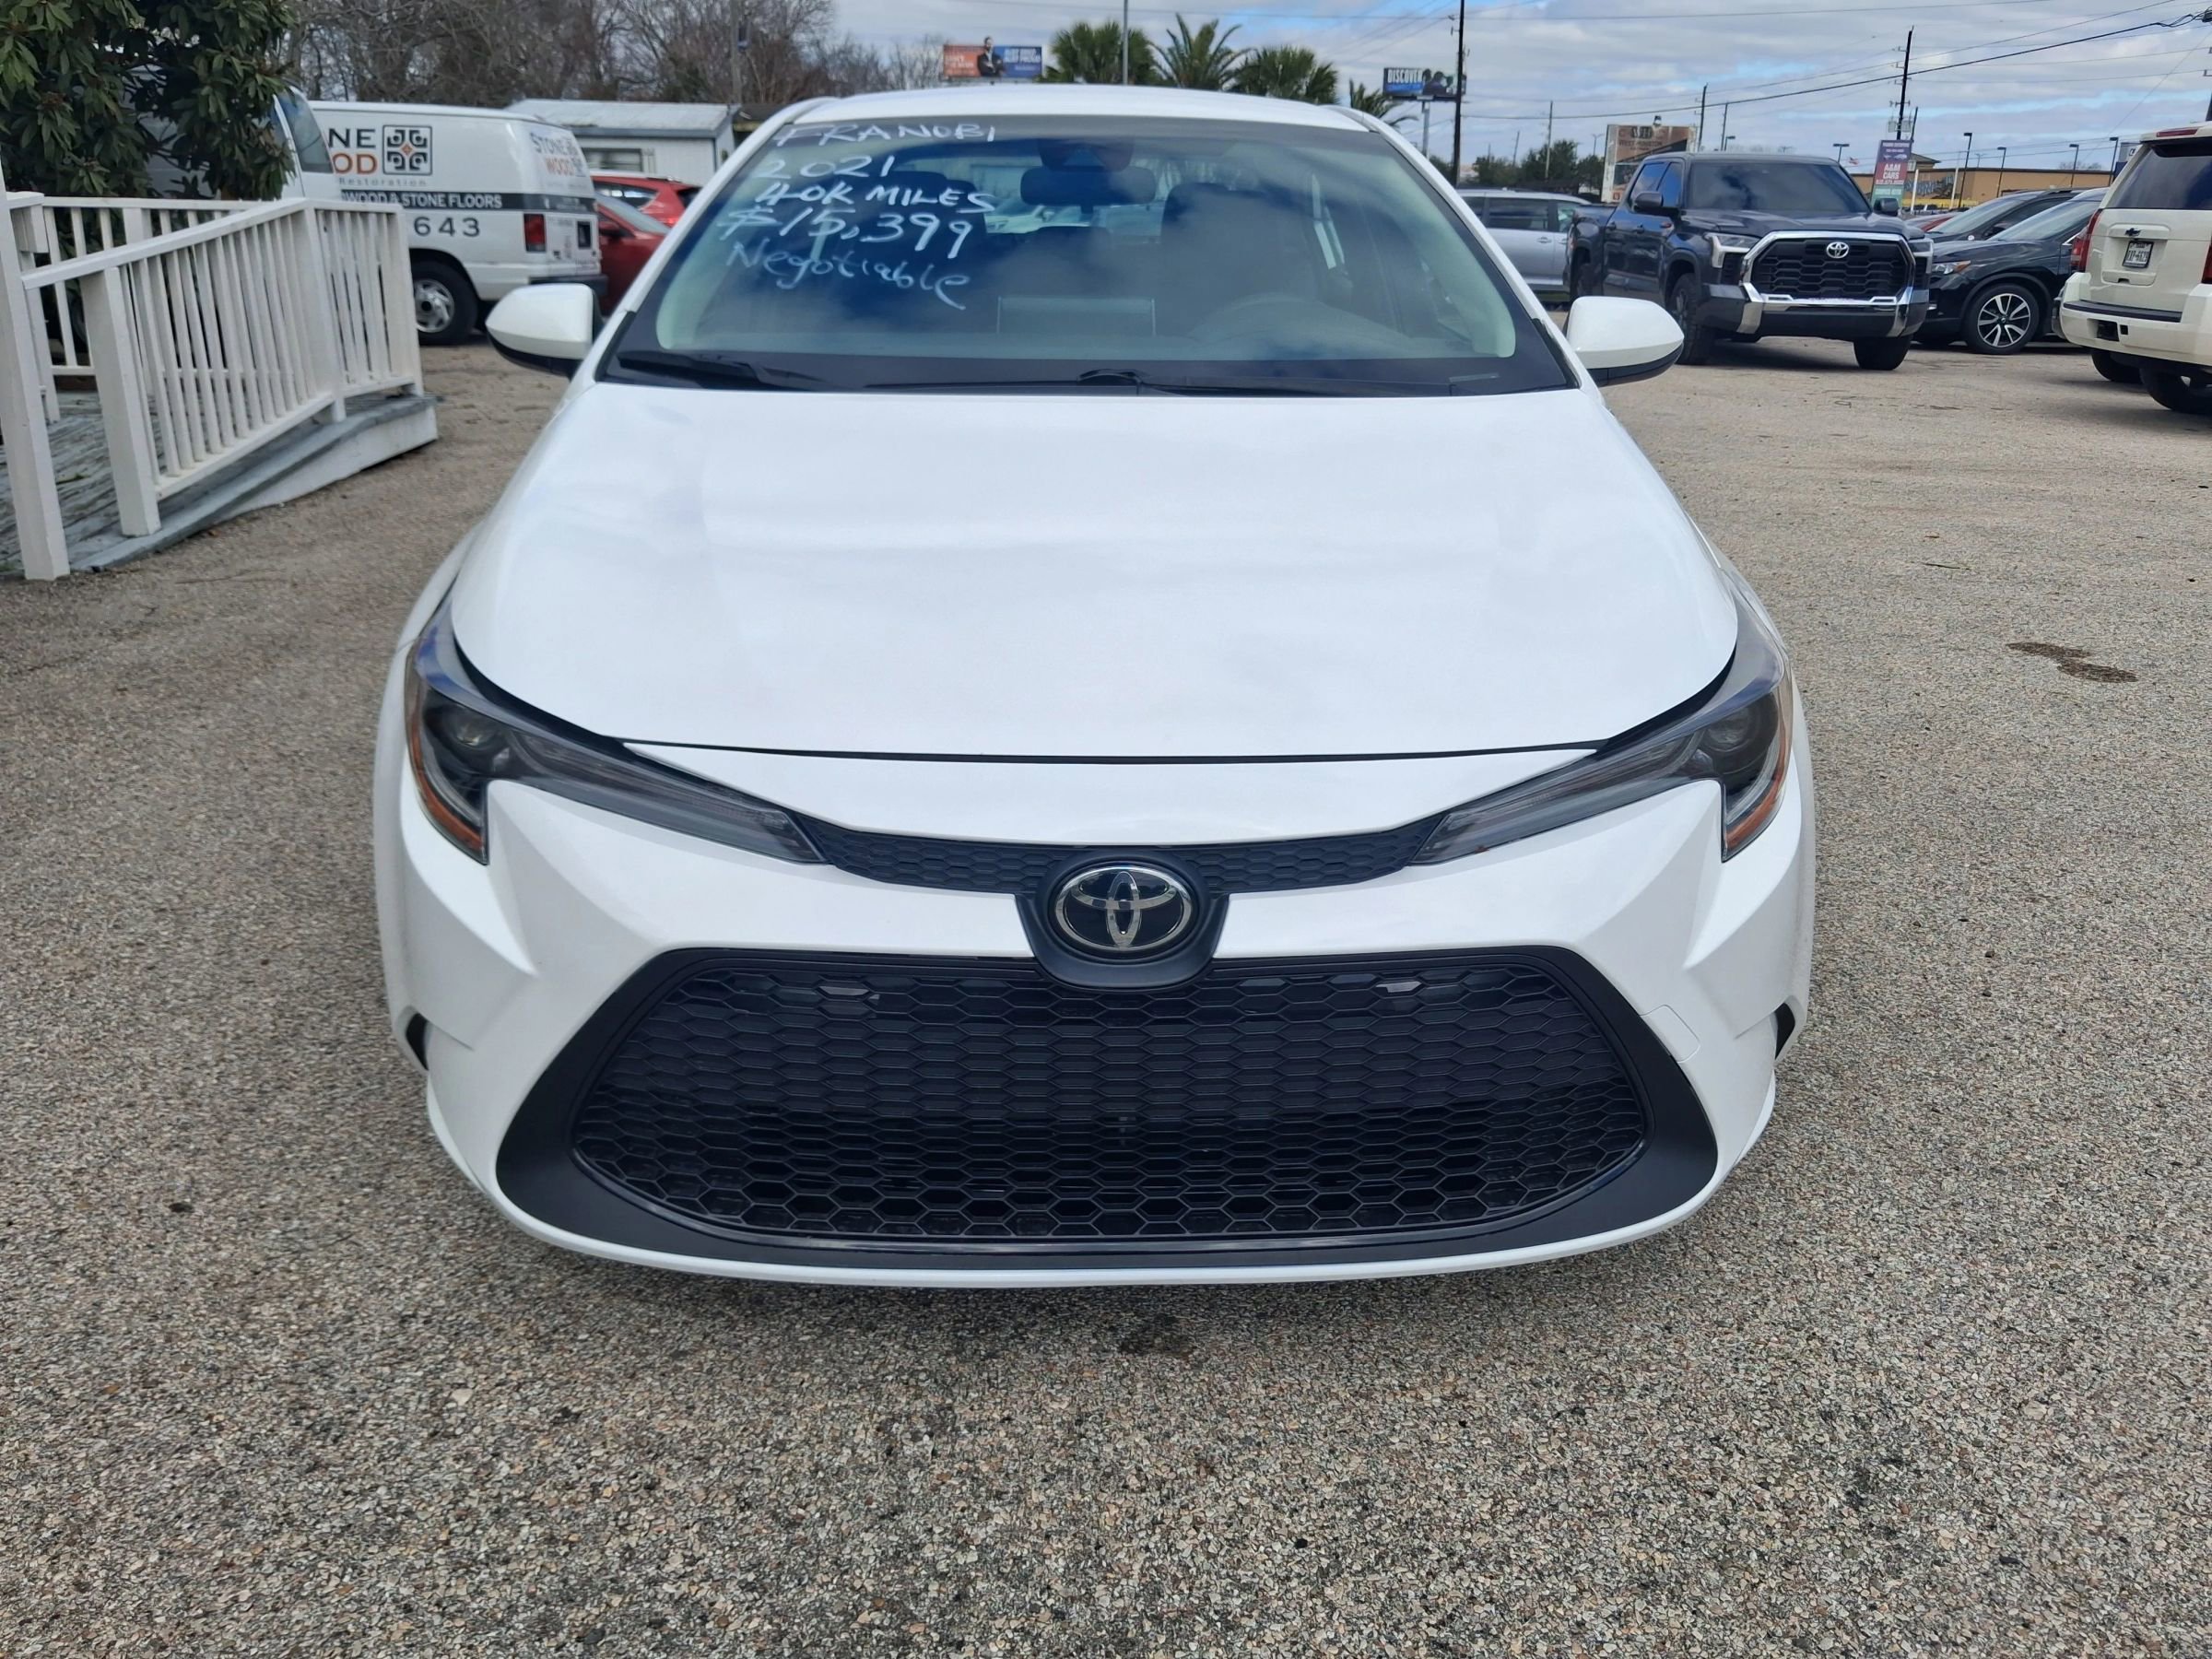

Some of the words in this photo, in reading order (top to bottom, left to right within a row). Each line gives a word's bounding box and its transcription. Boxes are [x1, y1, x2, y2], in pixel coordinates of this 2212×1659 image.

[753, 155, 895, 179] 2021
[338, 177, 427, 186] Restoration
[342, 191, 387, 203] WOOD
[402, 192, 447, 208] STONE
[448, 194, 503, 209] FLOORS
[754, 182, 854, 205] 40K
[865, 184, 996, 213] MILES
[413, 216, 480, 237] 643
[725, 237, 969, 311] Negotiable
